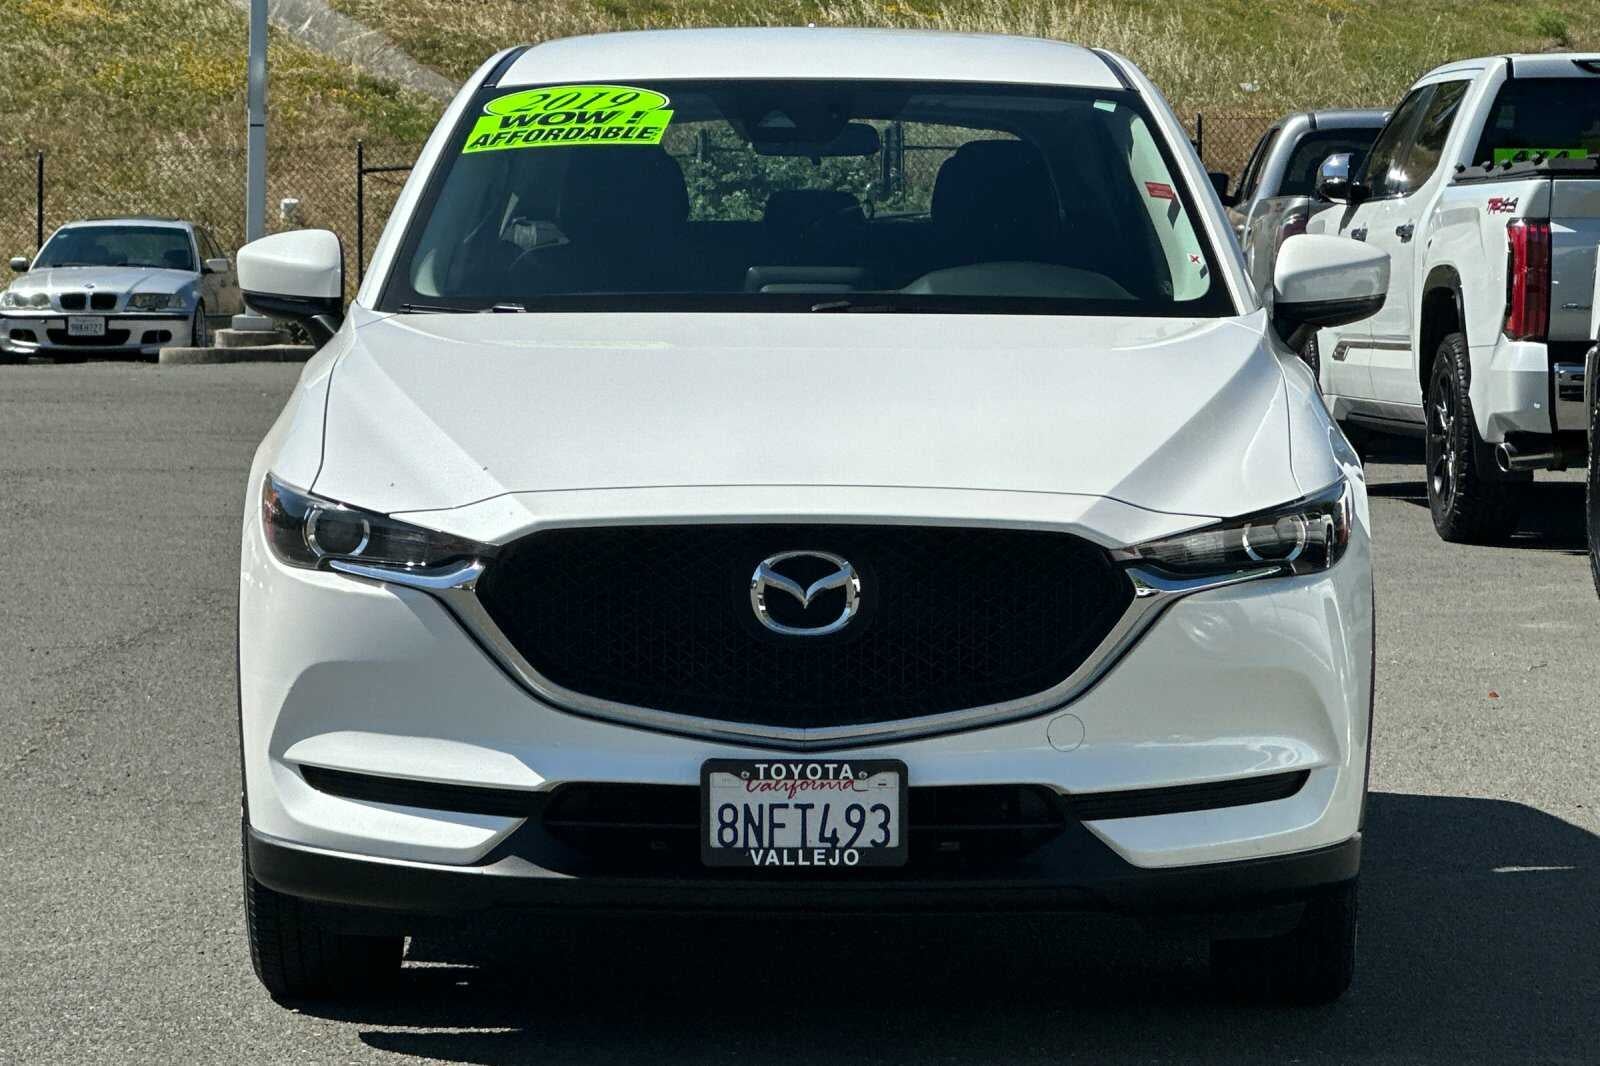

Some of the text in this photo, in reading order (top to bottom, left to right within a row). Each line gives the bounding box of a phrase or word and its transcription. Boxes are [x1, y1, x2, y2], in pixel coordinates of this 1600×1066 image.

[510, 91, 641, 111] 2019
[467, 126, 658, 148] AFFORDABLE
[754, 763, 855, 780] TOYOTA
[745, 778, 869, 800] California
[717, 803, 891, 848] 8NFT493
[750, 848, 860, 866] VALLEJO
